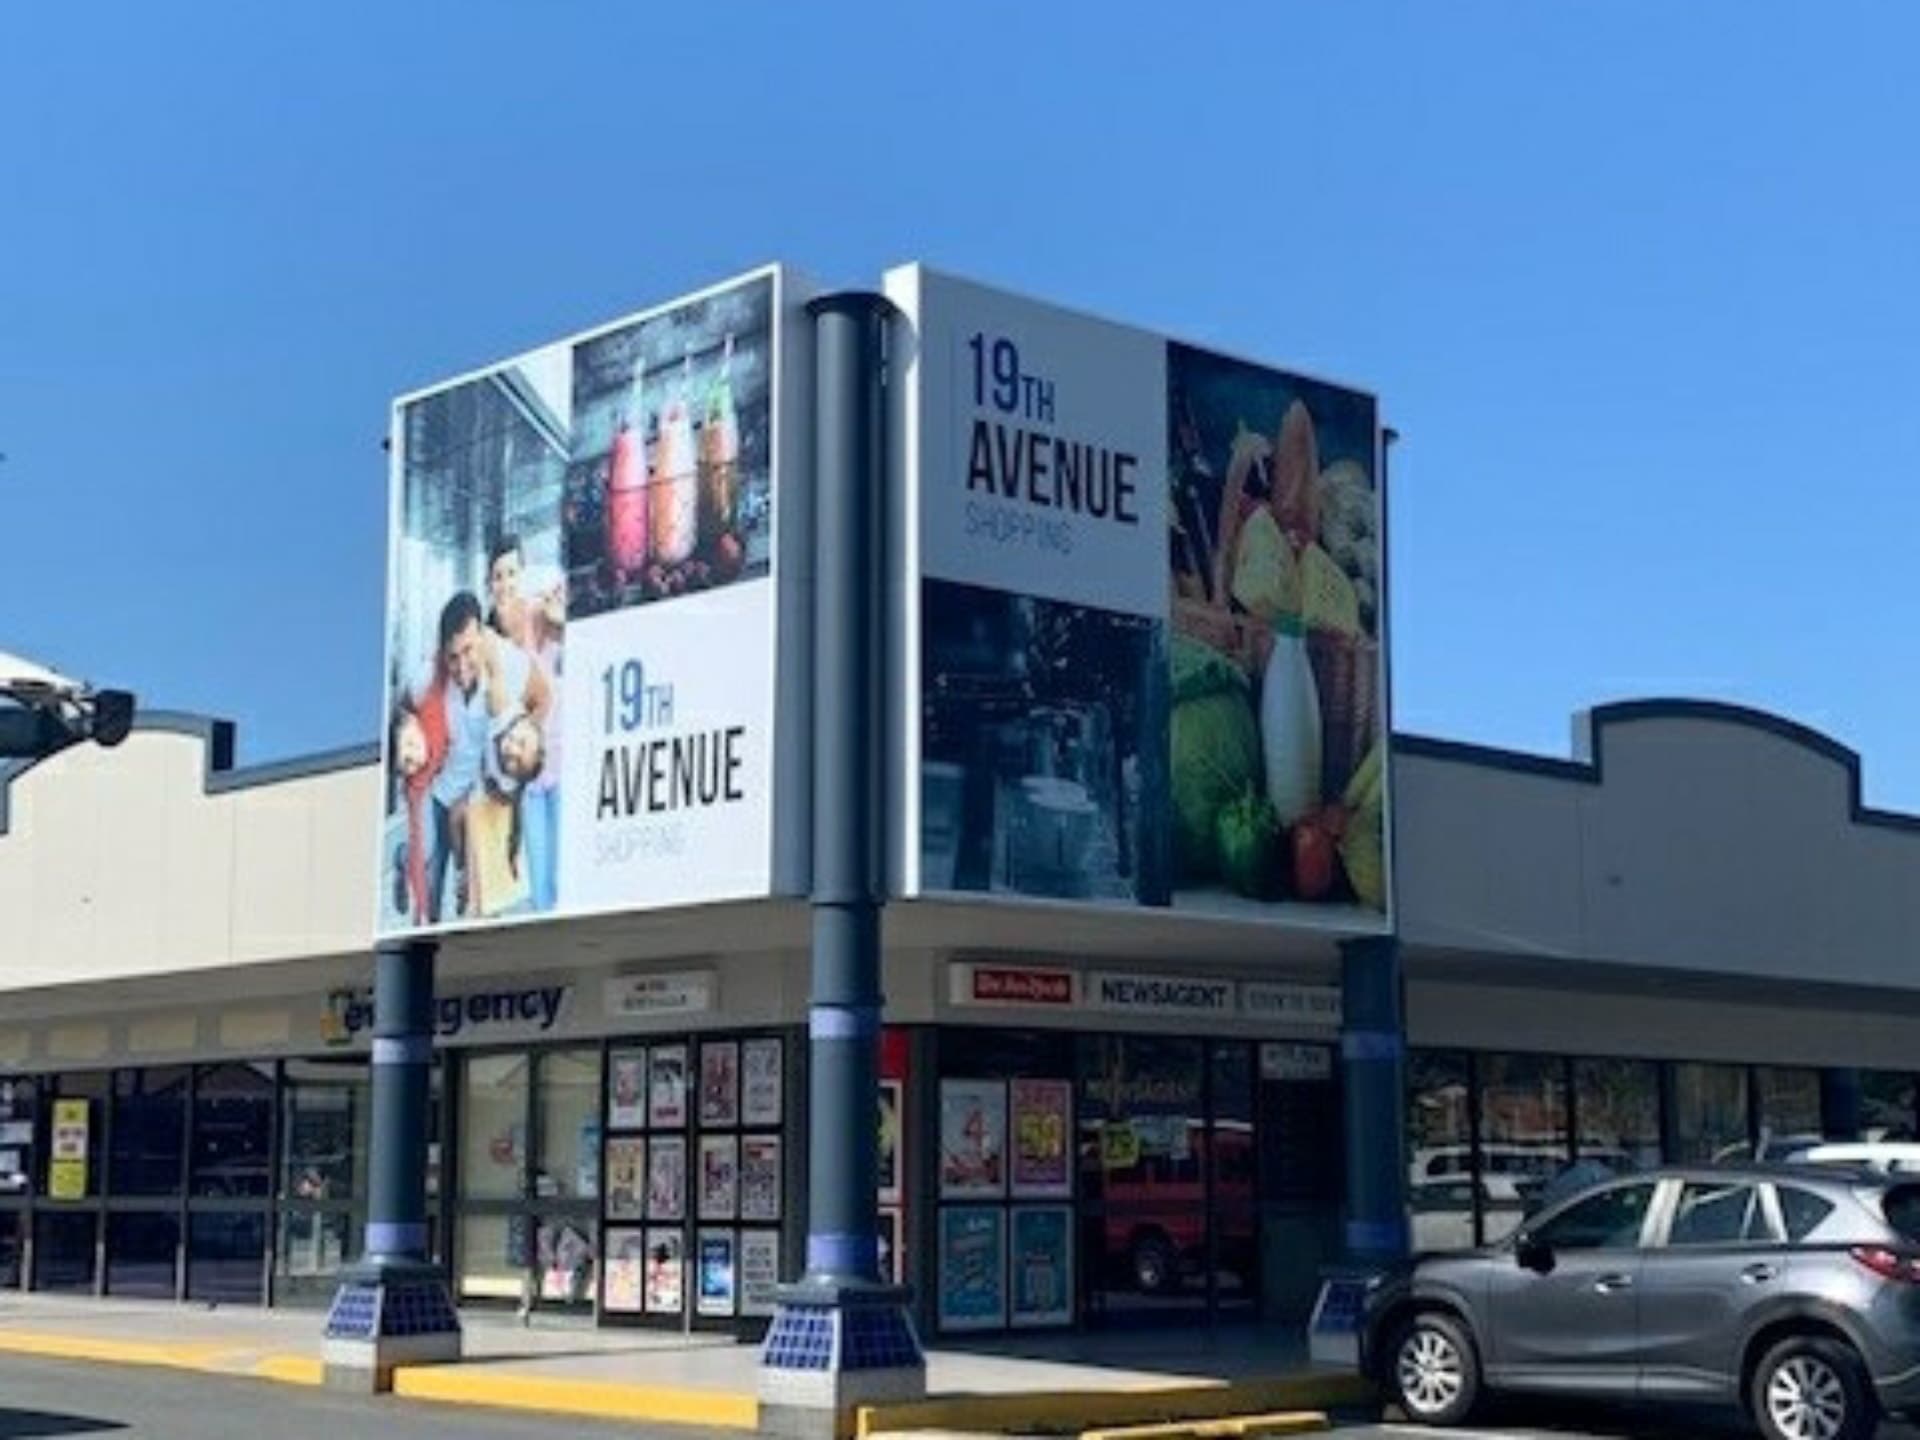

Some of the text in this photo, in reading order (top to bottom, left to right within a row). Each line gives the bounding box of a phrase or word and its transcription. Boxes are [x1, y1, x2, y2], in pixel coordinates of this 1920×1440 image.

[969, 331, 1055, 423] 19TH
[967, 420, 1138, 523] AVENUE
[965, 501, 1072, 556] SHOPPING
[601, 657, 674, 735] 19TH
[597, 726, 745, 820] AVENUE
[1101, 979, 1228, 1008] NEWSAGENT
